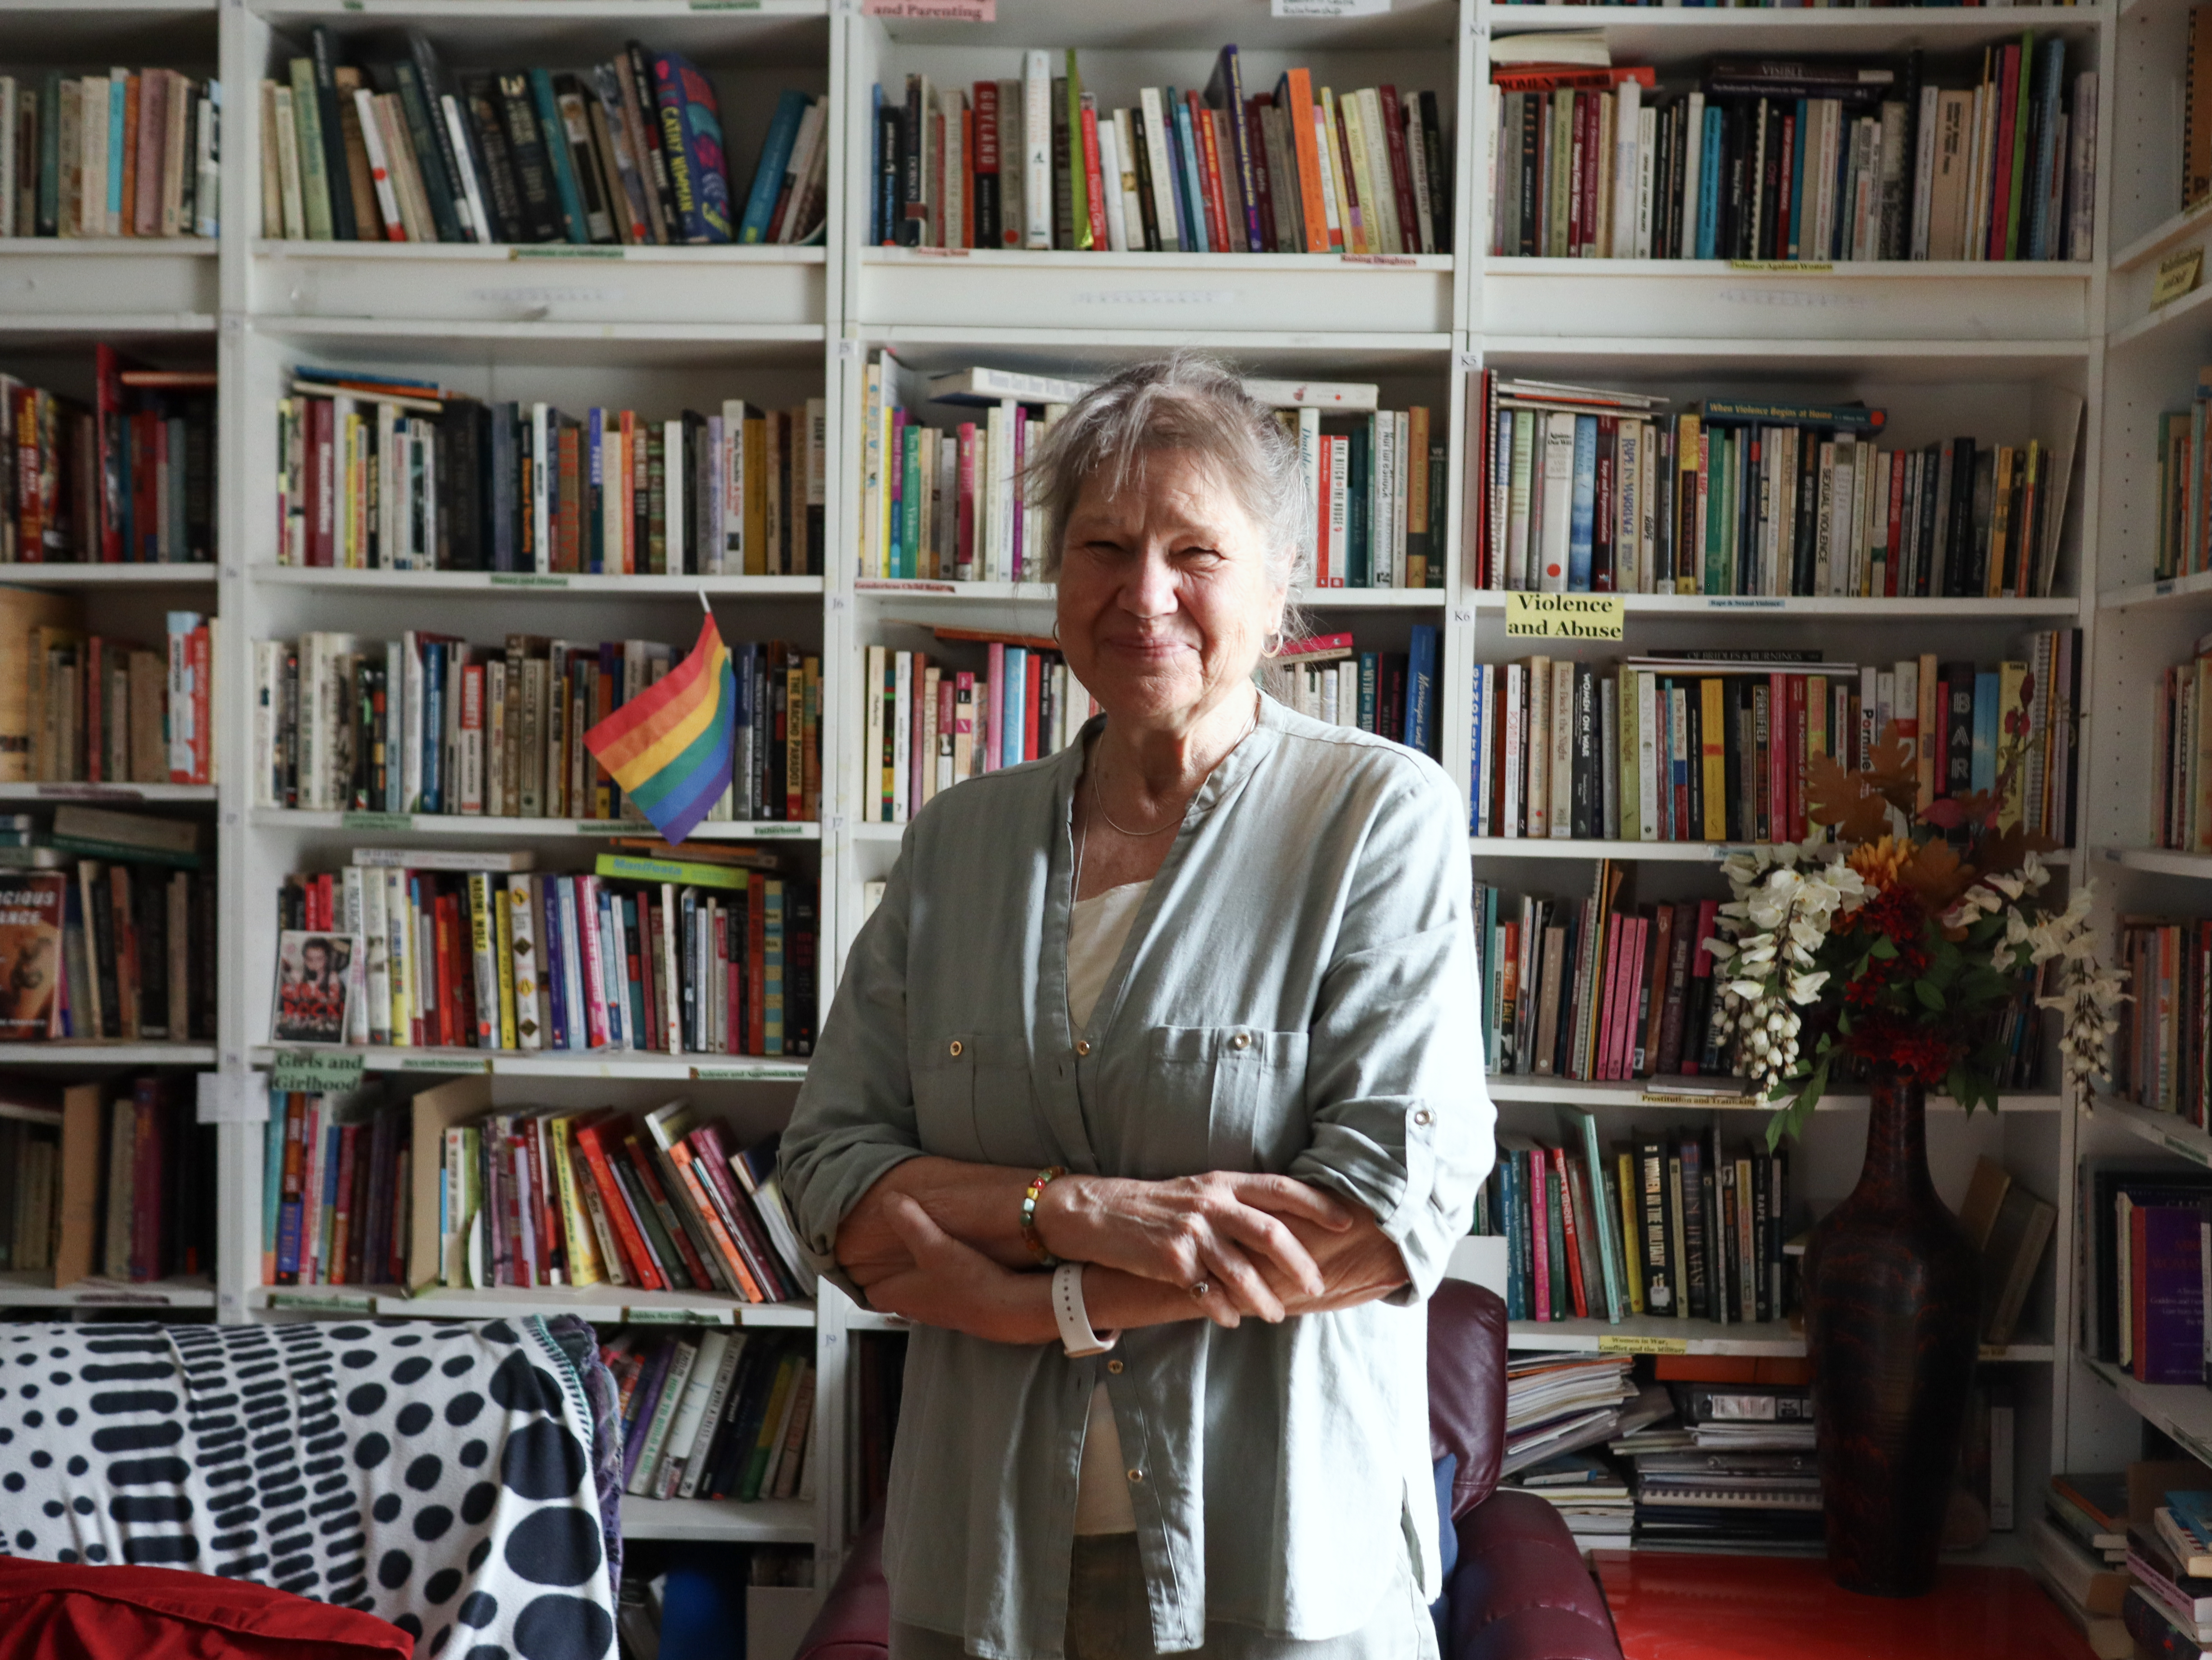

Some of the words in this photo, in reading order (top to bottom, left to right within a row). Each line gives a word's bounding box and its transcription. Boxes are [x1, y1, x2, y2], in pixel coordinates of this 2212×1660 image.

[873, 6, 903, 16] and
[908, 5, 982, 19] Parenting
[660, 107, 683, 155] CATHY
[980, 91, 995, 164] GUYLAND
[1784, 127, 1793, 144] STOP
[1414, 121, 1426, 182] REDEFINING
[1572, 142, 1582, 171] Stopping
[1256, 167, 1266, 192] Girls
[1571, 171, 1582, 193] Family
[1089, 174, 1100, 212] Raising
[1419, 185, 1429, 214] GIRLY
[1571, 194, 1581, 222] Violence
[1093, 212, 1104, 236] Girls
[1363, 197, 1376, 247] DAUGHTERS
[1374, 256, 1416, 266] Daughters
[1769, 262, 1798, 271] Against
[1709, 402, 1733, 413] When
[1735, 405, 1768, 415] Violence
[1771, 406, 1796, 419] Begins
[1809, 410, 1832, 419] Home
[909, 433, 918, 449] Ten
[1301, 428, 1312, 469] Double
[1334, 442, 1344, 456] THE
[1622, 438, 1636, 465] RAPE
[1576, 428, 1585, 478] SILENCE
[1699, 437, 1708, 474] STOPPING
[1334, 459, 1344, 480] BITCH
[1382, 432, 1394, 499] NurtureShock
[1601, 460, 1609, 478] Rape
[1623, 468, 1635, 479] IN
[319, 442, 332, 534] Masculinities
[1334, 488, 1343, 501] THE
[1698, 476, 1707, 496] RAPE
[1821, 468, 1832, 509] SEXUAL
[1333, 503, 1343, 525] HOUSE
[1384, 501, 1391, 514] PO
[1600, 492, 1609, 543] Representation
[1621, 483, 1634, 536] MARRIAGE
[558, 501, 579, 568] GUYS
[908, 507, 917, 543] Violence
[1643, 516, 1654, 542] RAPE
[1818, 511, 1831, 564] VIOLENCE
[1518, 593, 1613, 612] Violence
[1508, 621, 1548, 635] and
[1555, 620, 1622, 639] Abuse
[789, 677, 801, 694] THE
[1363, 669, 1374, 694] MYTH
[1559, 667, 1569, 687] Take
[1623, 671, 1633, 691] Take
[754, 673, 763, 713] THROUGH
[1325, 679, 1336, 699] Bad
[1413, 671, 1430, 724] Marriages
[1582, 672, 1590, 712] WOMEN
[1391, 693, 1399, 719] should
[1559, 691, 1569, 714] Back
[1623, 693, 1633, 717] Back
[1641, 679, 1652, 726] OBSCENE
[754, 715, 763, 729] THE
[790, 700, 802, 736] MACHO
[1362, 713, 1373, 731] BAD
[1559, 718, 1568, 733] the
[1581, 715, 1590, 732] ON
[1623, 719, 1633, 733] the
[1675, 715, 1683, 733] Porn
[1756, 688, 1767, 742] PORNIFIED
[754, 731, 762, 747] EYES
[1415, 726, 1425, 745] and
[1508, 711, 1518, 756] PORNLAND
[1674, 735, 1684, 754] Trap
[754, 749, 762, 759] OF
[1557, 735, 1568, 761] Night
[1581, 734, 1590, 758] WAR
[1623, 737, 1633, 762] Night
[754, 761, 762, 775] THE
[789, 740, 801, 787] PARADOX
[754, 826, 801, 835] Fatherhood
[612, 857, 681, 875] Manifesta
[470, 875, 488, 915] NAOMI
[471, 919, 490, 952] WOLF
[284, 1001, 344, 1017] ROCK!
[1502, 1001, 1513, 1023] SALE
[277, 1055, 323, 1070] Girls
[328, 1054, 364, 1070] and
[274, 1075, 360, 1092] Girlhood
[1642, 1095, 1692, 1103] Prostitution
[1711, 1097, 1757, 1106] Trafficking
[1644, 1157, 1660, 1193] WOMEN
[588, 1191, 600, 1214] Sex
[1562, 1193, 1572, 1225] GENDER
[1645, 1195, 1662, 1205] IN
[1535, 1209, 1544, 1226] STOP
[1646, 1207, 1662, 1224] THE
[1535, 1229, 1544, 1243] THE
[1647, 1225, 1665, 1267] MILITARY
[725, 1350, 739, 1368] LAST
[1657, 1347, 1685, 1355] Military
[720, 1368, 733, 1385] TIME
[665, 1378, 679, 1401] HOW
[710, 1390, 724, 1408] WORE
[660, 1403, 671, 1416] TO
[726, 1394, 741, 1423] myself
[649, 1418, 667, 1444] BUILD
[640, 1455, 656, 1474] GIRL
